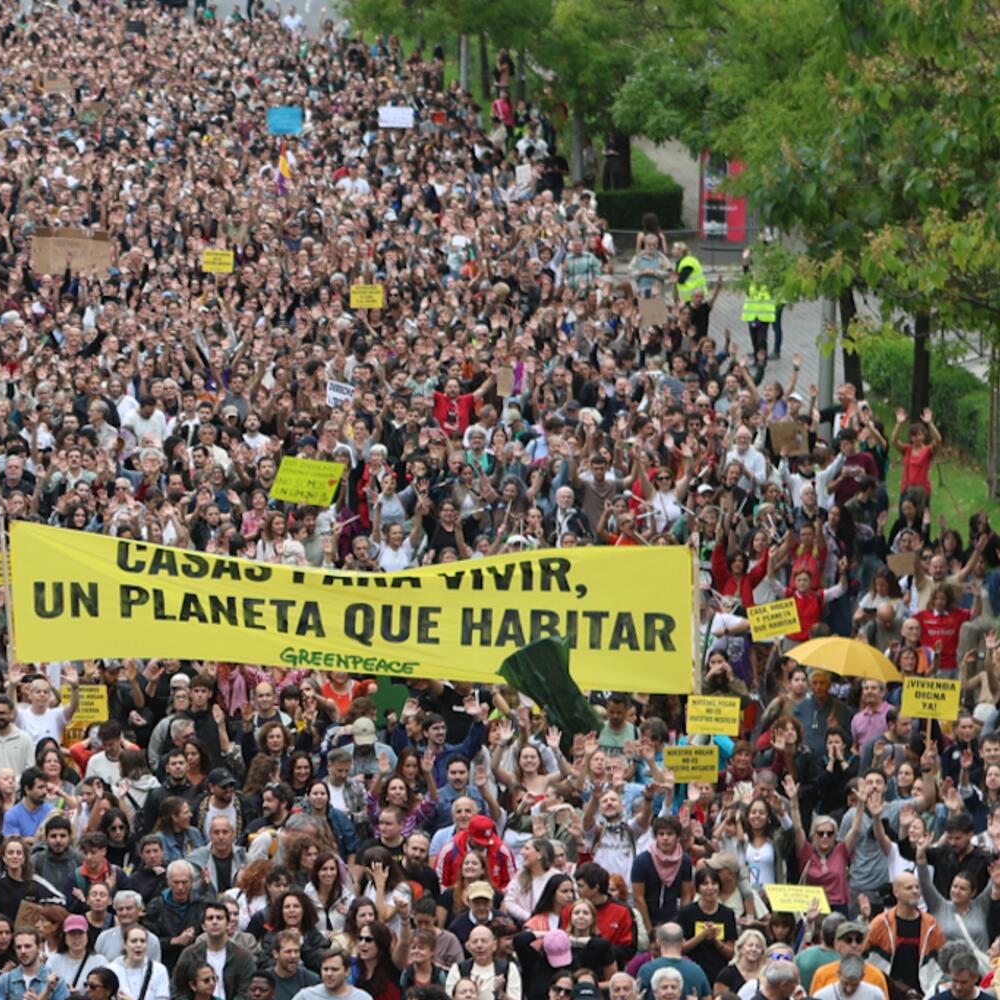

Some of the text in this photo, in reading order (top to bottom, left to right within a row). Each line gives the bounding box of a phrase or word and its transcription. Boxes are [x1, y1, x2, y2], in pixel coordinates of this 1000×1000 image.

[116, 541, 272, 582] CASAS
[34, 582, 677, 651] UN PLANETA QUE HABITAR
[280, 647, 420, 674] GREENPEACE
[906, 679, 956, 691] ¡VIVIENDA
[915, 690, 946, 701] DIGNA
[922, 701, 937, 711] YA!
